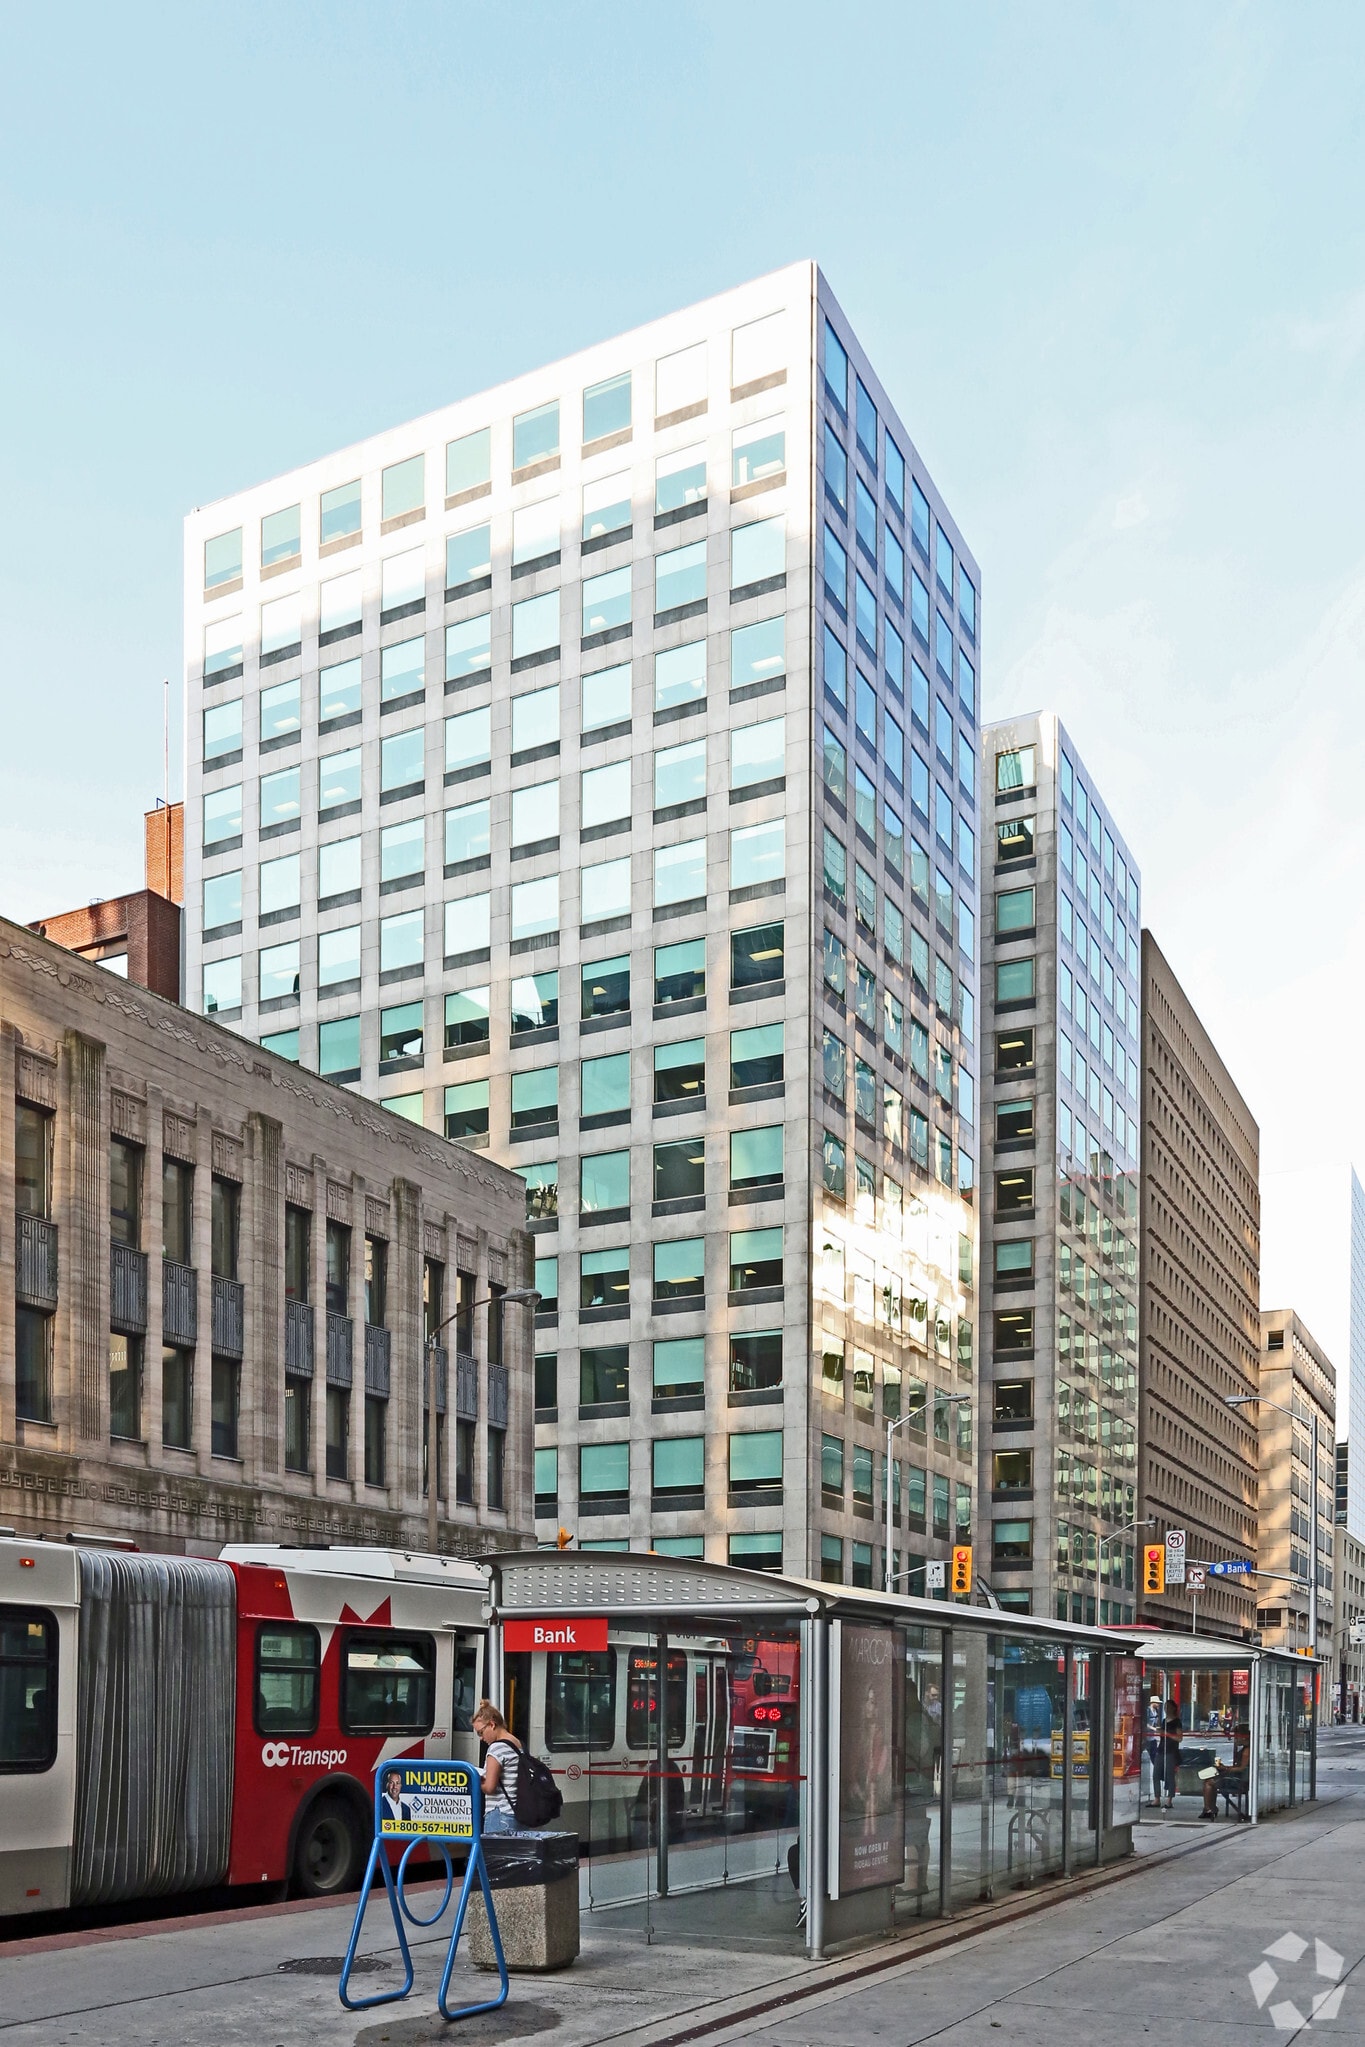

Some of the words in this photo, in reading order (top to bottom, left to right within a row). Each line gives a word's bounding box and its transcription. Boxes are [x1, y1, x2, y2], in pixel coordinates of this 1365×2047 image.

[1227, 1564, 1247, 1573] Bank
[534, 1626, 576, 1643] Bank
[431, 1731, 446, 1739] pop
[262, 1742, 289, 1767] OC
[290, 1746, 347, 1769] Transpo
[405, 1771, 468, 1787] INJURED
[424, 1798, 466, 1807] DIAMOND
[392, 1822, 470, 1834] 1-800-567-HURT
